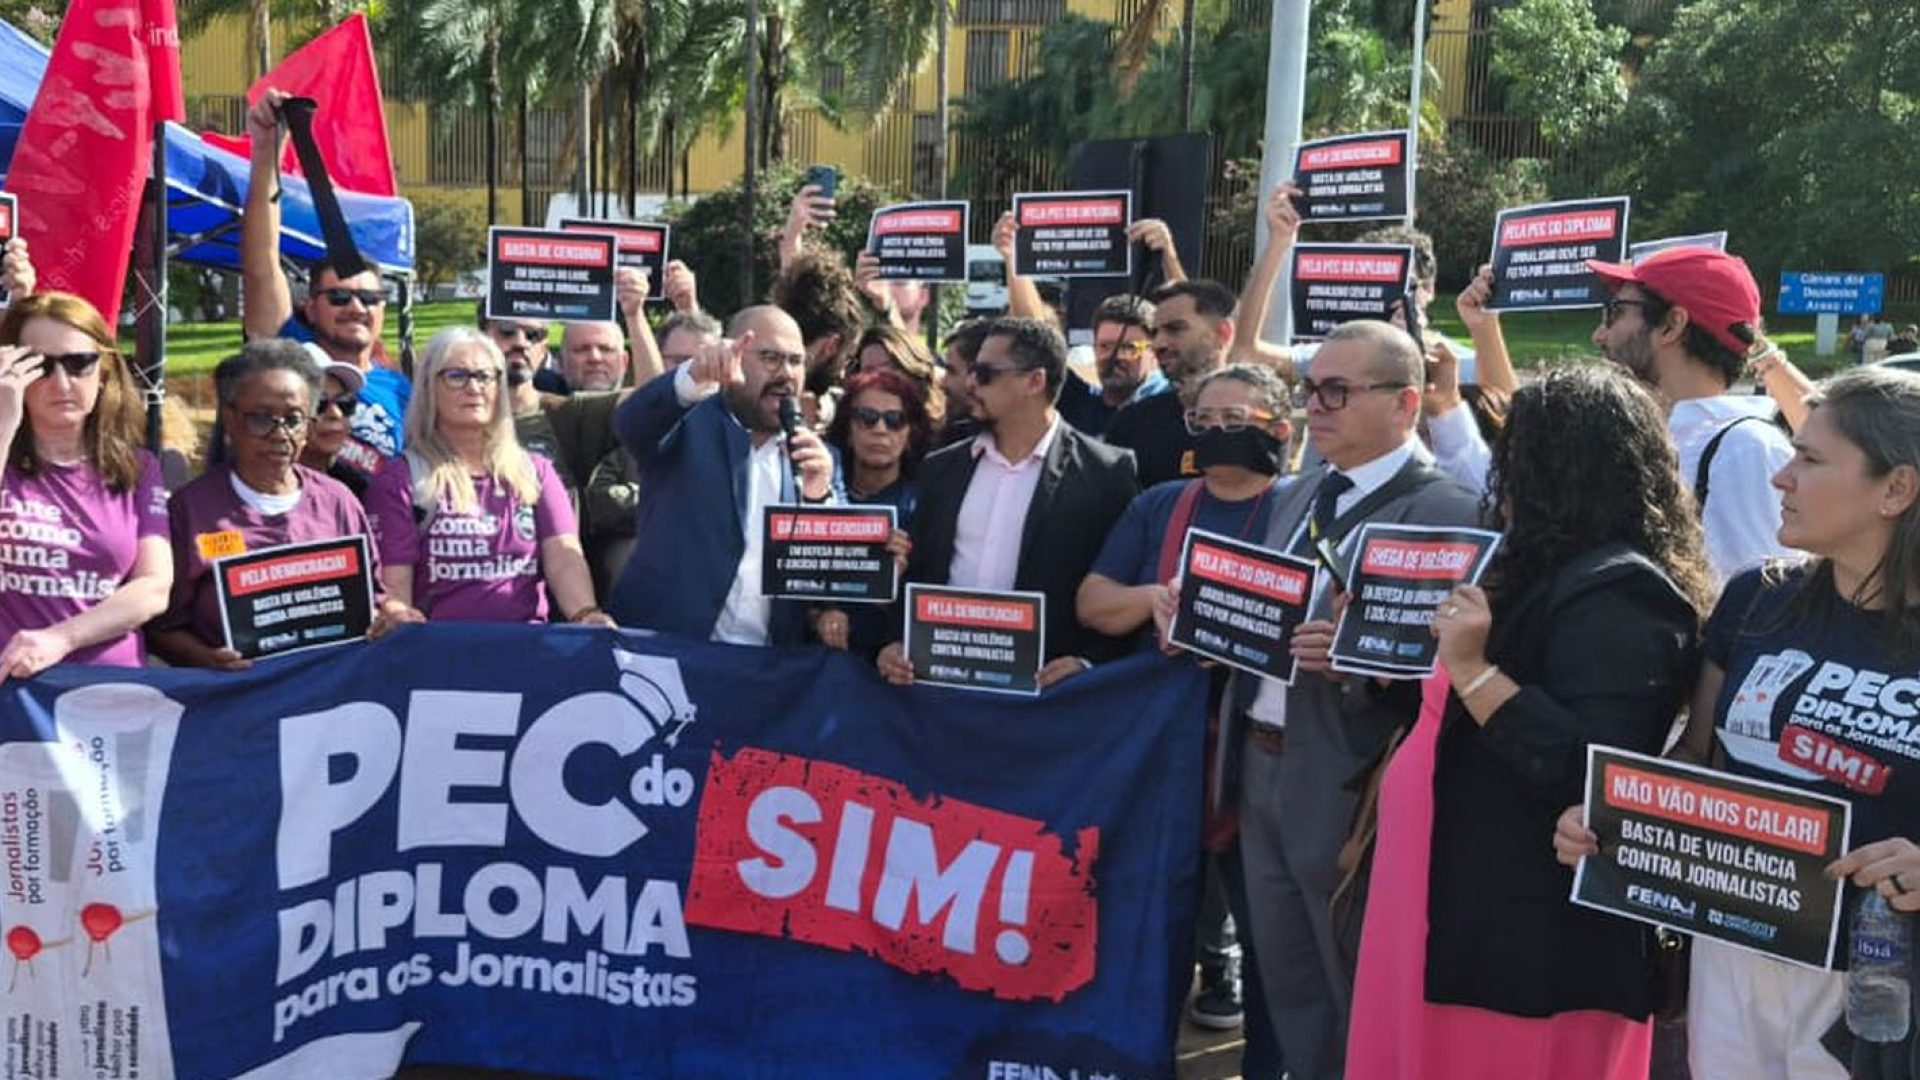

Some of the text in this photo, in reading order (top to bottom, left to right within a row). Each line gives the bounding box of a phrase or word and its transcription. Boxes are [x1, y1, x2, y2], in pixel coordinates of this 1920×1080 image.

[429, 537, 490, 556] uma
[1806, 661, 1920, 717] PEC
[276, 690, 695, 890] PEC do
[1792, 734, 1876, 786] SIM!
[1613, 775, 1820, 844] NÃO VÃO NOS CALAR!
[2, 791, 25, 904] Jornalistas
[737, 785, 1035, 965] SIM!
[1616, 845, 1801, 912] CONTRA JORNALISTAS
[1621, 820, 1797, 882] BASTA DE VIOLÊNCIA
[29, 877, 46, 904] por
[276, 861, 692, 987] DIPLOMA
[1627, 884, 1696, 918] FENAJ
[273, 942, 698, 1043] para os Jornalistas
